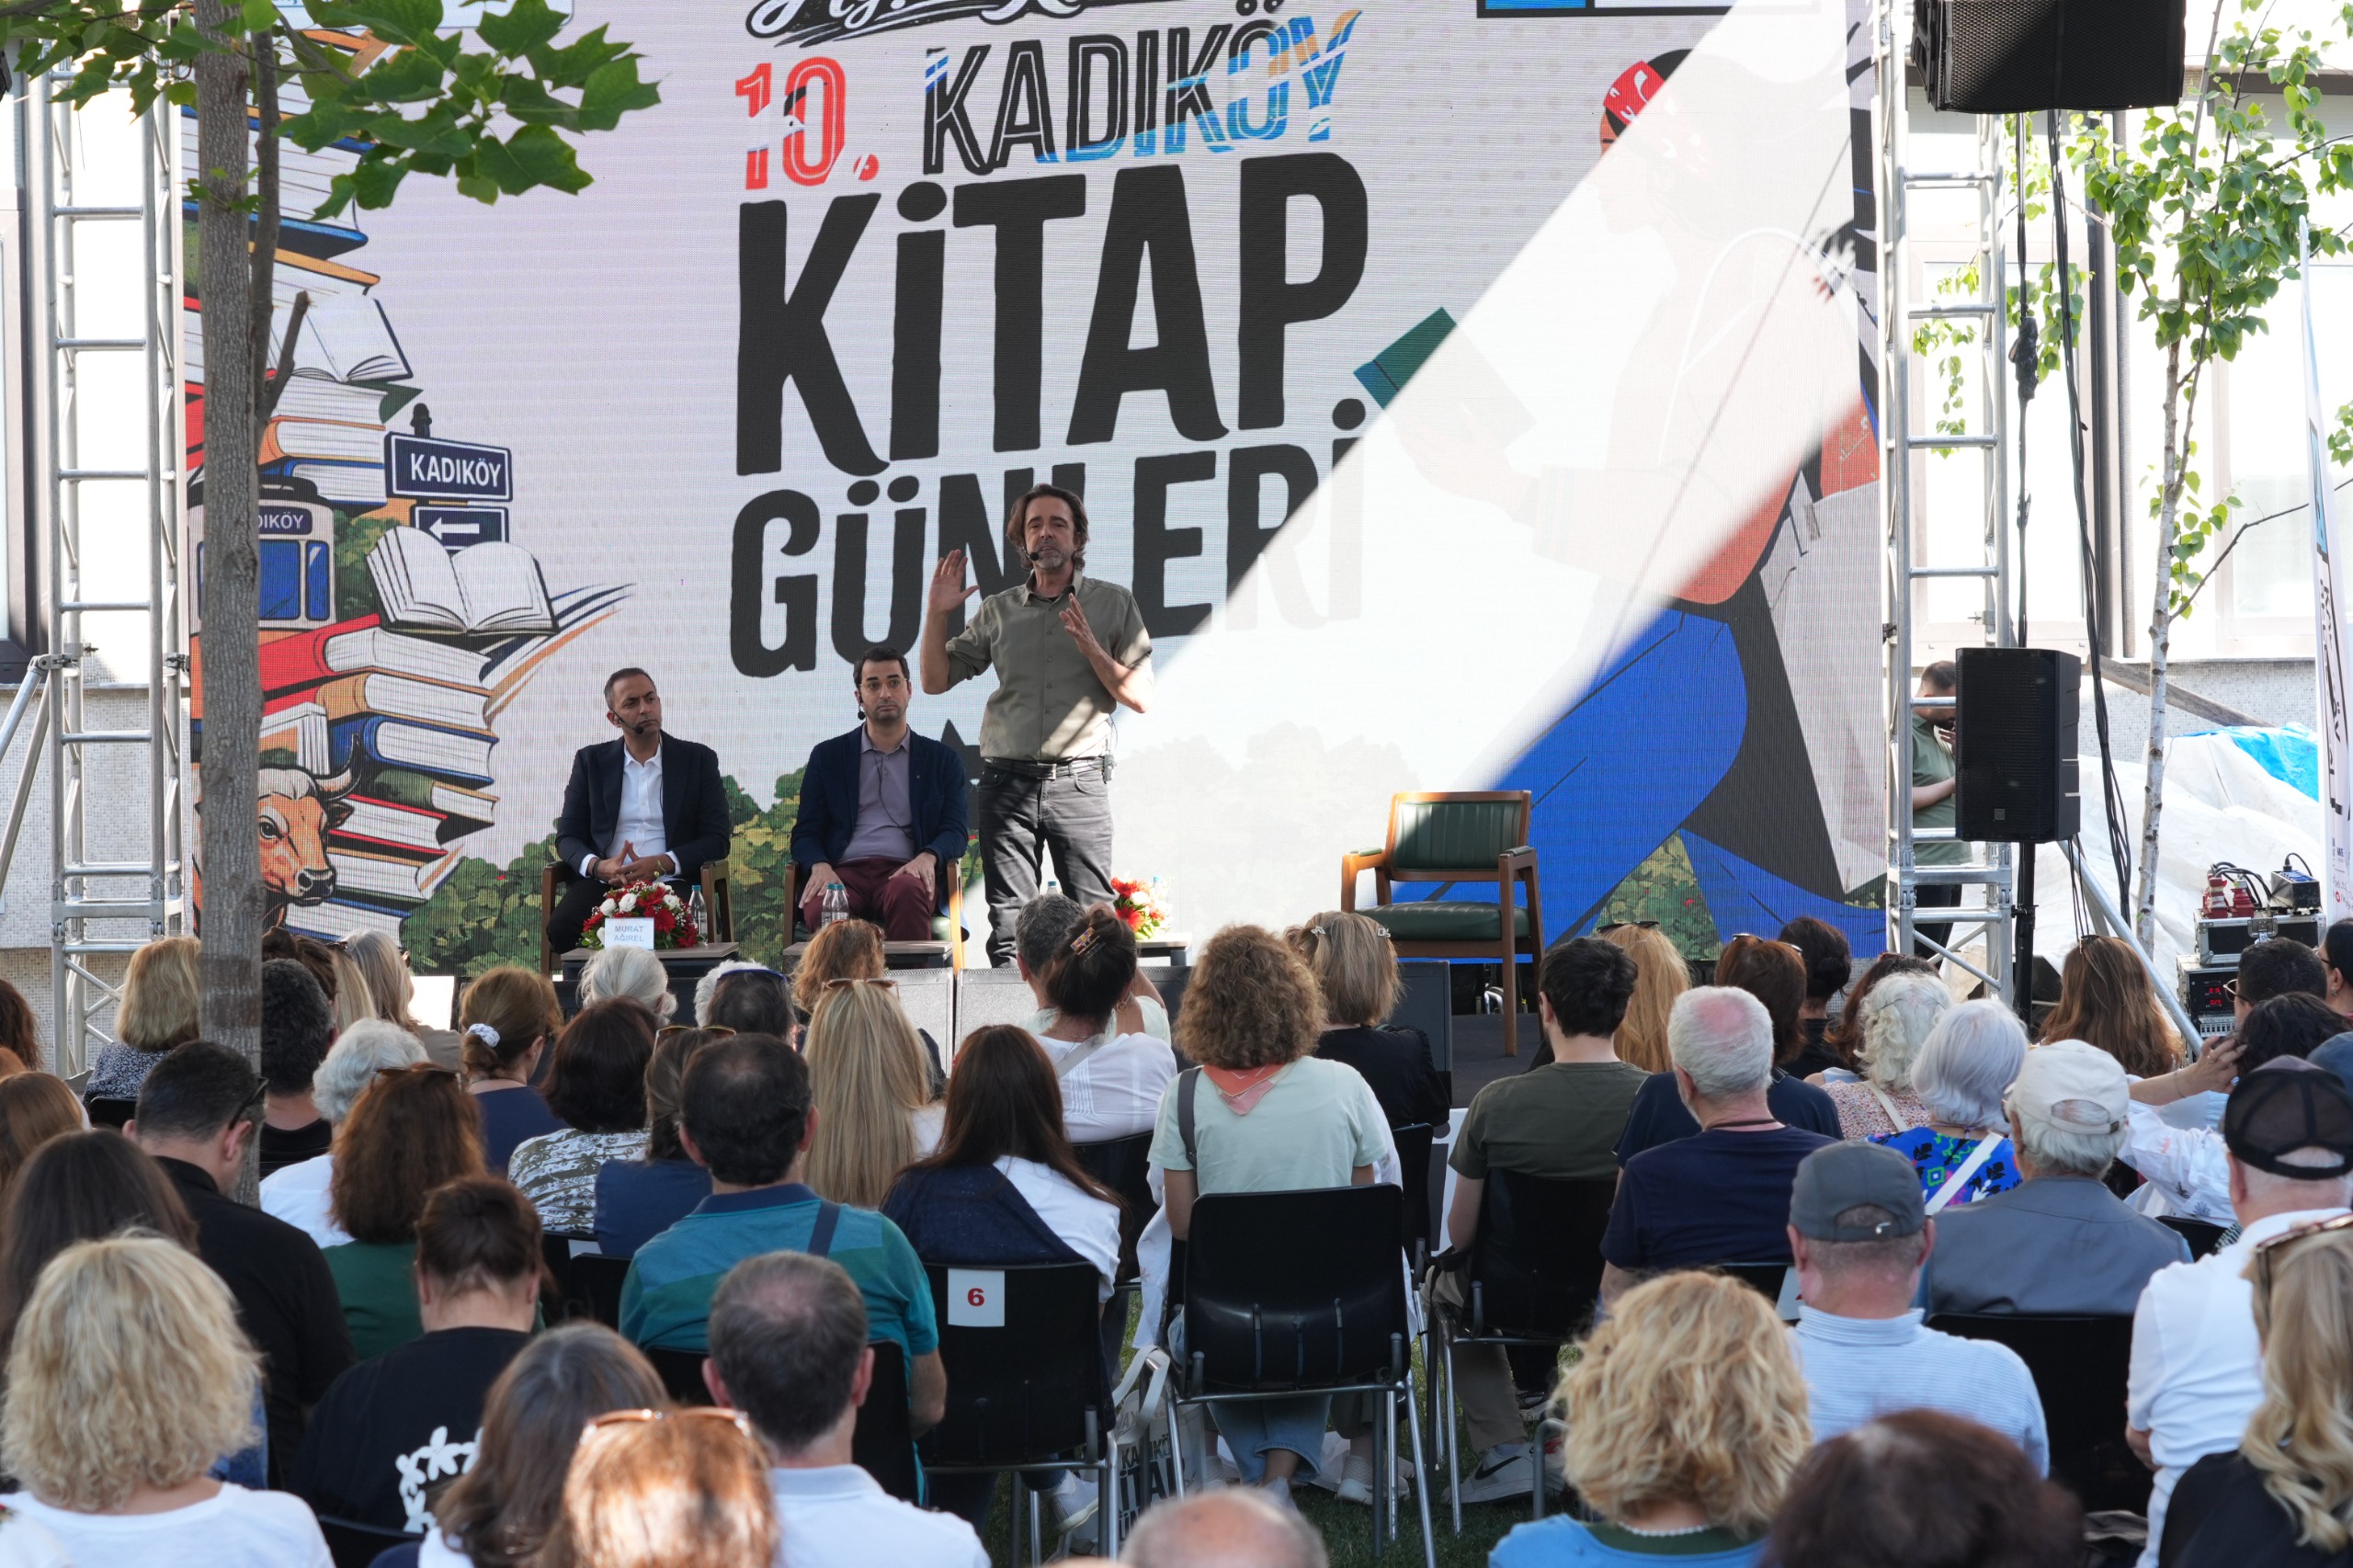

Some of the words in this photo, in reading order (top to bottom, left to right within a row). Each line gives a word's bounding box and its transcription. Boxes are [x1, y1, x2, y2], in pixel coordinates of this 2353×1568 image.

[922, 0, 1364, 176] KADIKÖY
[410, 452, 502, 488] KADIKÖY
[729, 397, 1367, 678] GÜNERİ
[614, 933, 644, 942] AĞIREL
[967, 1288, 985, 1307] 6
